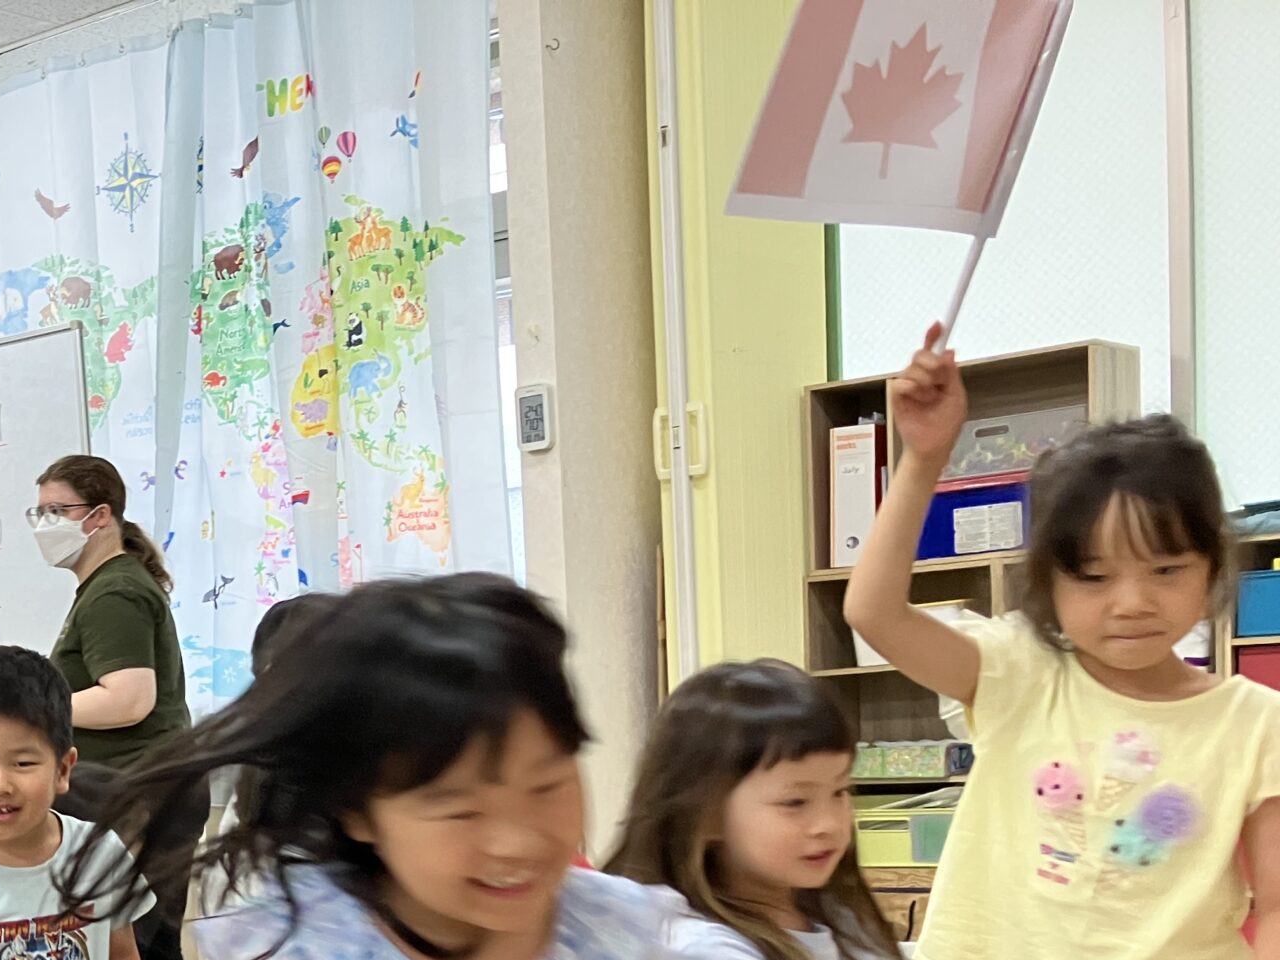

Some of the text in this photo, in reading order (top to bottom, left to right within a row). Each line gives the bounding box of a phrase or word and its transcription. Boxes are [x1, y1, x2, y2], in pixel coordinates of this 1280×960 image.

[350, 279, 370, 294] Asia
[397, 508, 440, 519] Australia
[398, 521, 436, 533] Oceania
